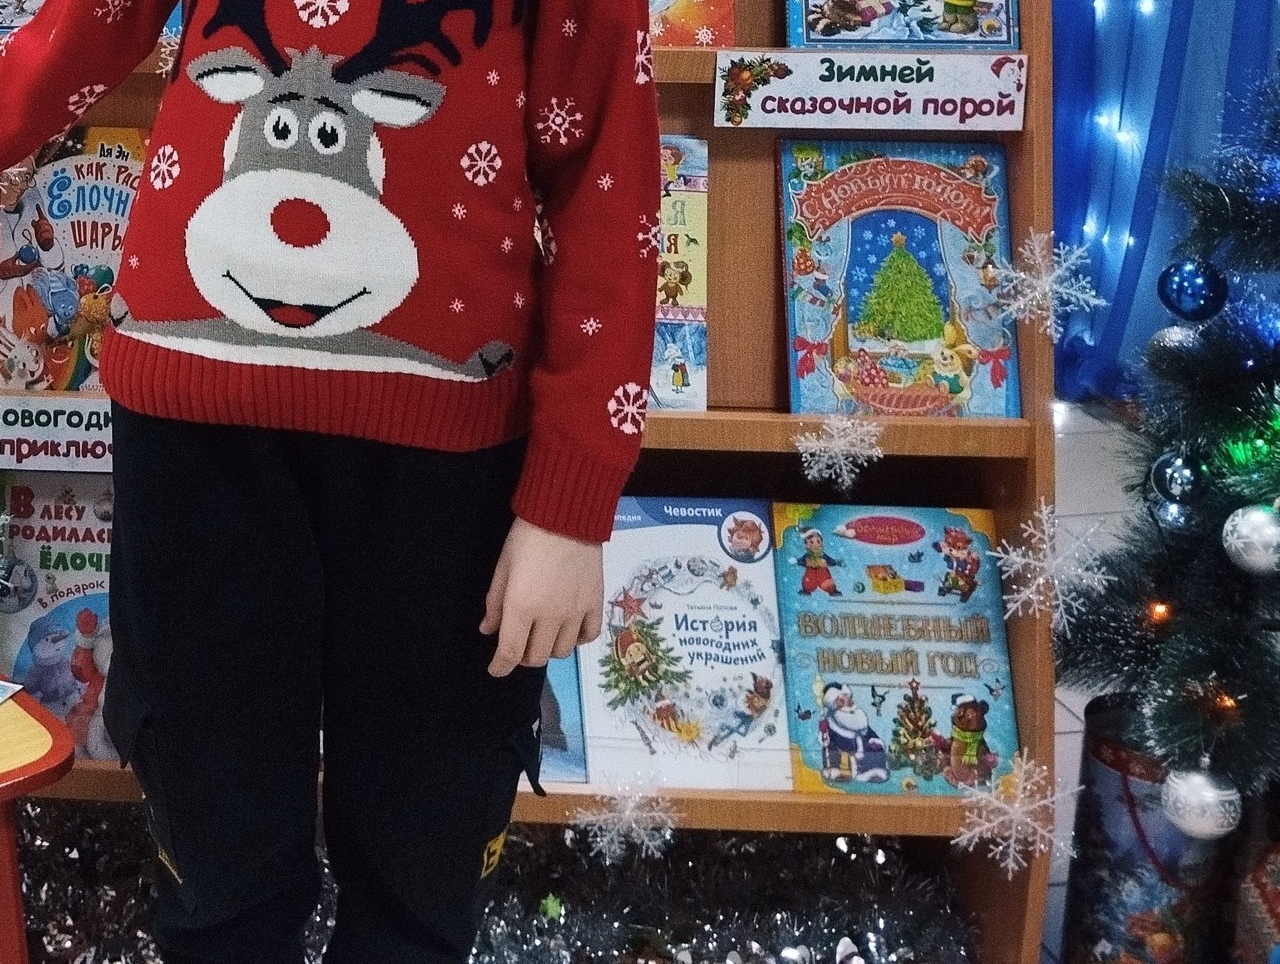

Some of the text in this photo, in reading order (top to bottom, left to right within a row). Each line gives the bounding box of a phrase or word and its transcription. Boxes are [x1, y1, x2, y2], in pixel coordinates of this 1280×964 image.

[819, 58, 934, 83] Зимней
[761, 90, 1016, 123] сказочной порой
[74, 162, 107, 181] КАК
[10, 485, 86, 521] В ЛЕСУ
[664, 505, 723, 517] Чевостик
[679, 636, 758, 653] новогодних
[688, 649, 767, 666] украшений
[817, 646, 979, 678] НОВЫЙ ГОД
